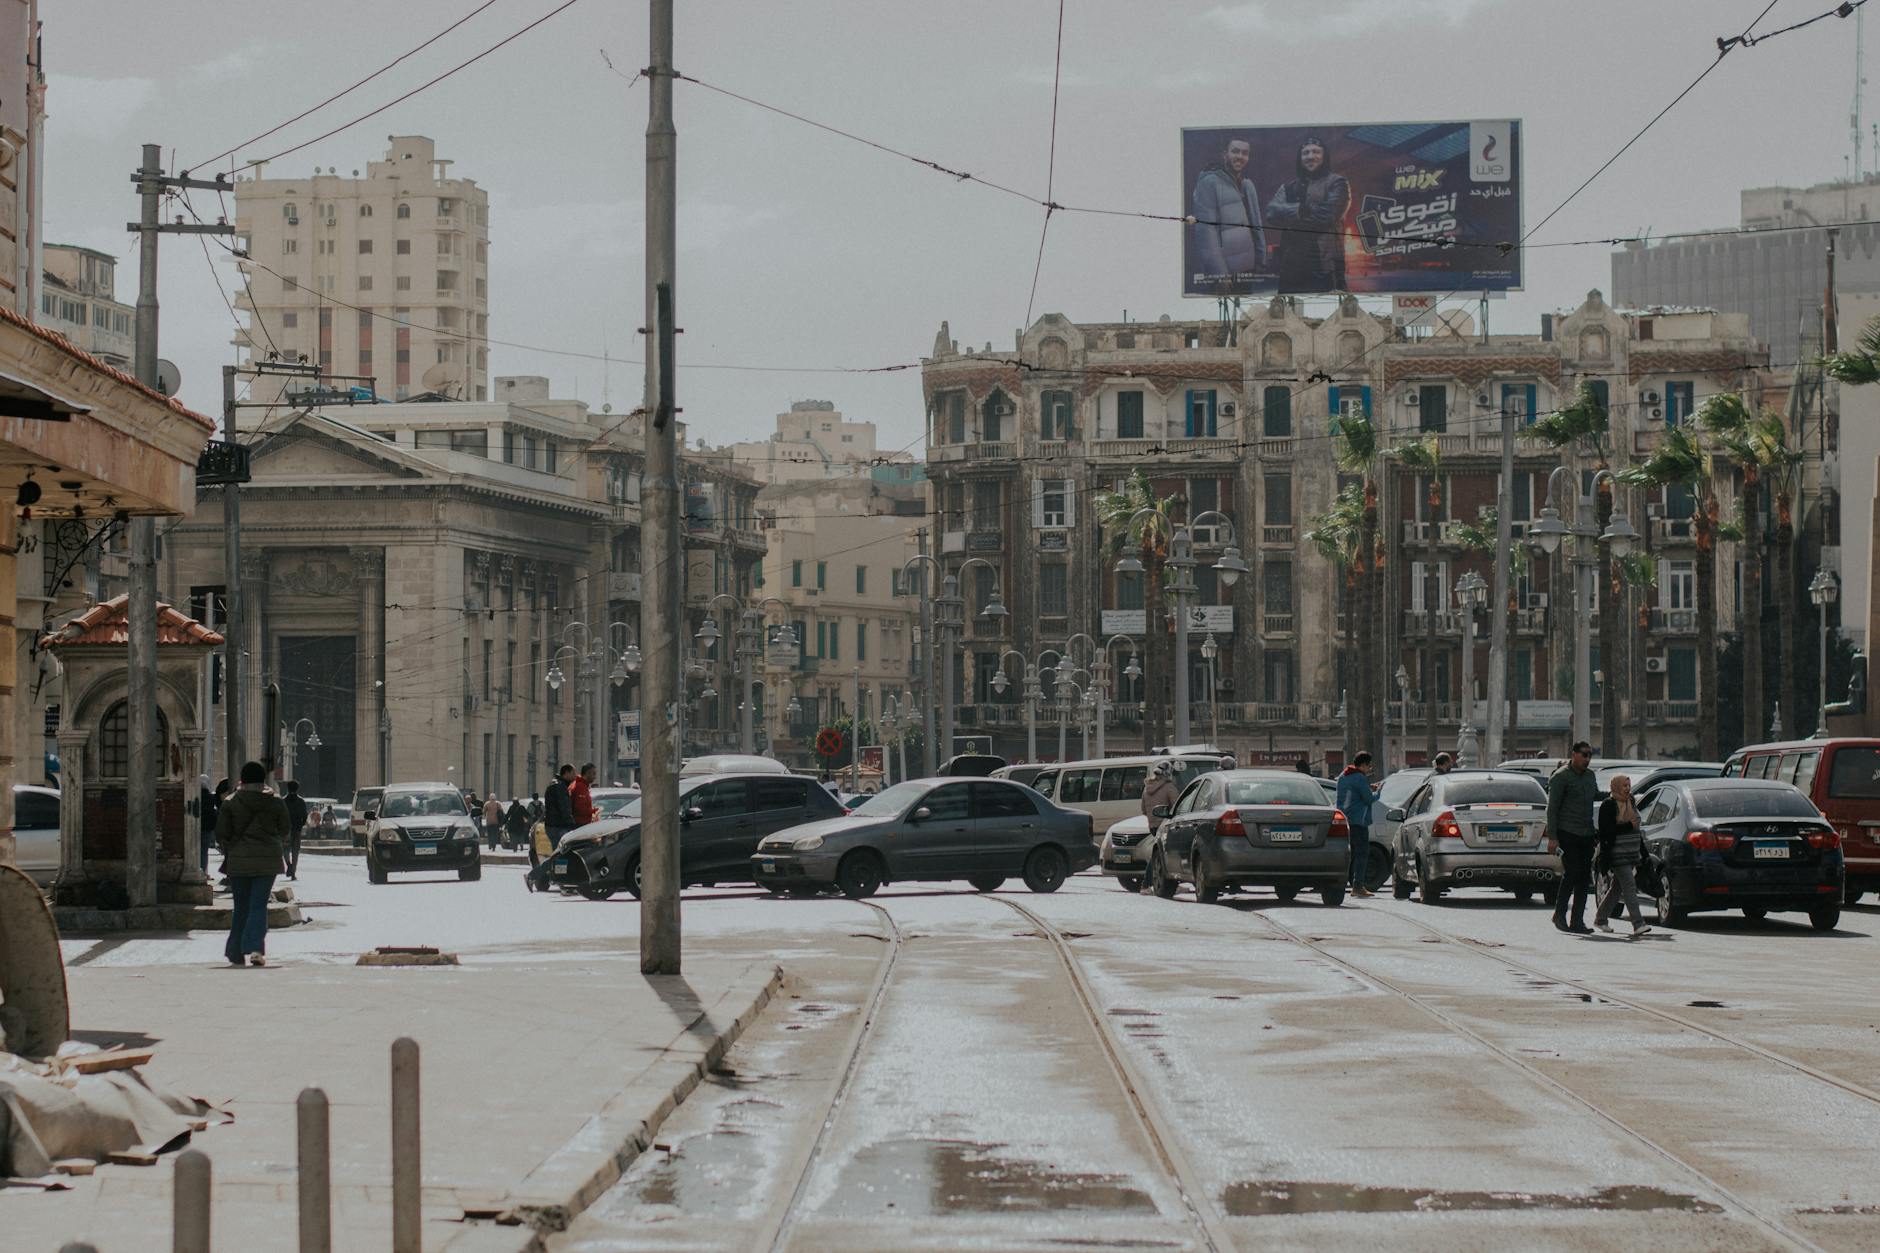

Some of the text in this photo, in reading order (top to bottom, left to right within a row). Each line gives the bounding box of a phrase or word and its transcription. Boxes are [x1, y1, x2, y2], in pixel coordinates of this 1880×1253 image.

[1380, 192, 1458, 225] أقوى
[1376, 218, 1457, 246] ميكس
[1375, 245, 1406, 257] واحد
[1398, 297, 1429, 308] LOOK
